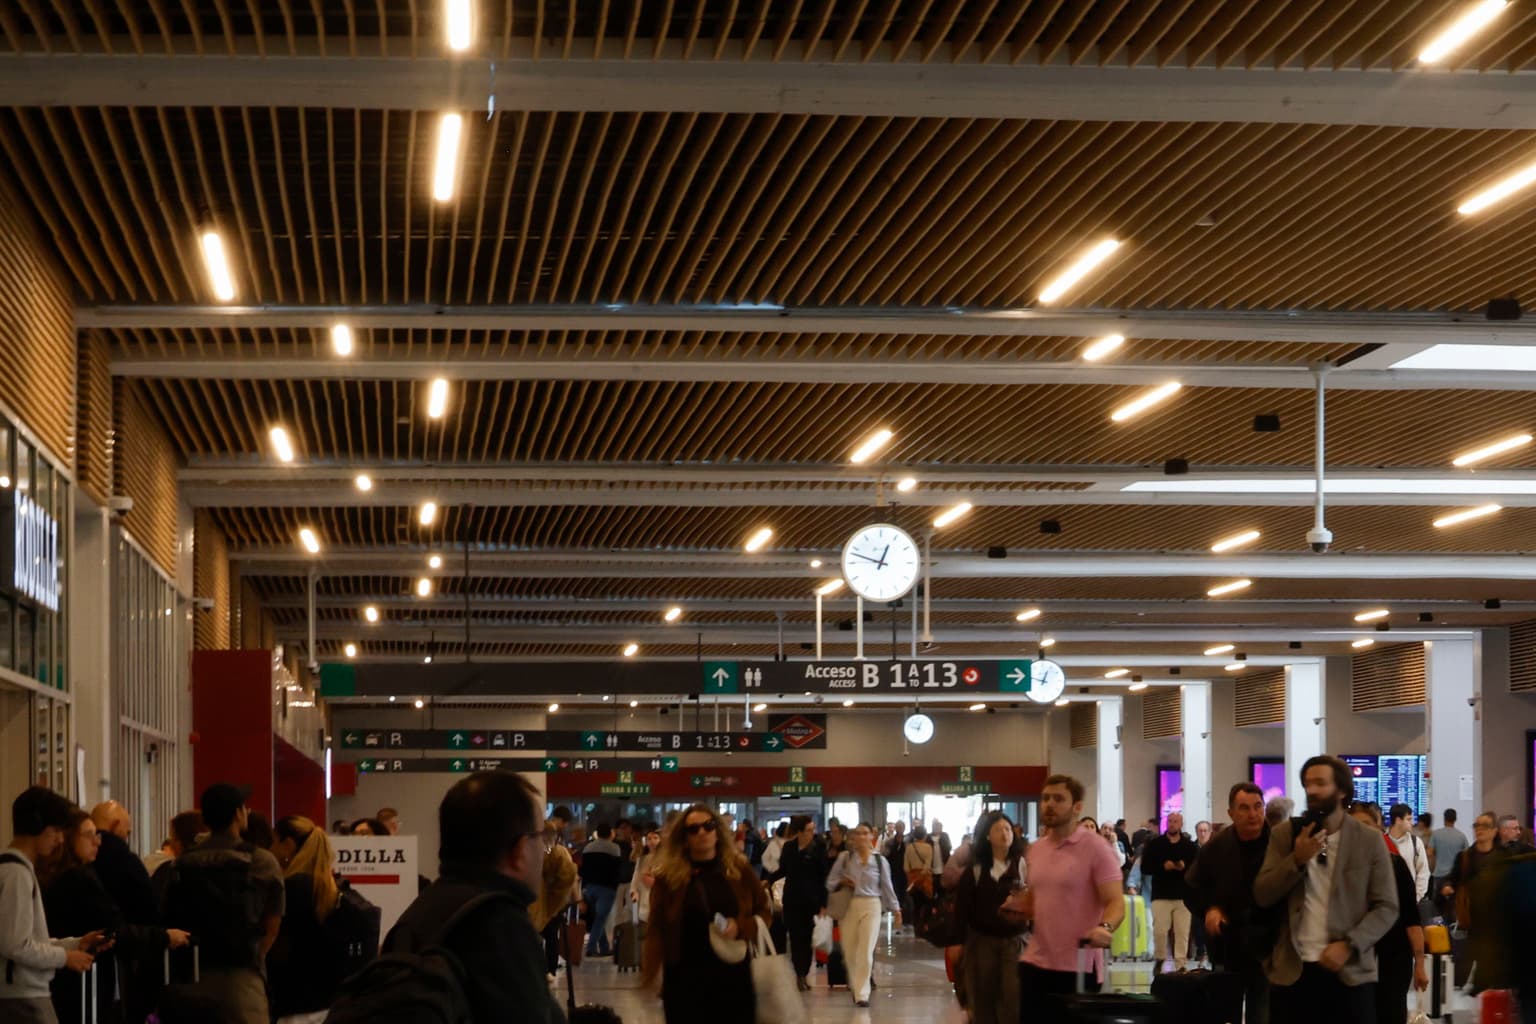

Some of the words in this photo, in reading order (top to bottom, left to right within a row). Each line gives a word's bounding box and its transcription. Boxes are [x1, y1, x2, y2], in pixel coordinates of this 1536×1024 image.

[805, 664, 856, 679] Acceso
[862, 664, 880, 688] B
[890, 664, 906, 688] 1
[909, 664, 919, 677] A
[923, 664, 957, 688] 13
[828, 679, 856, 688] ACCESS
[909, 679, 919, 688] TO
[672, 735, 681, 749] B
[338, 849, 406, 863] DILLA
